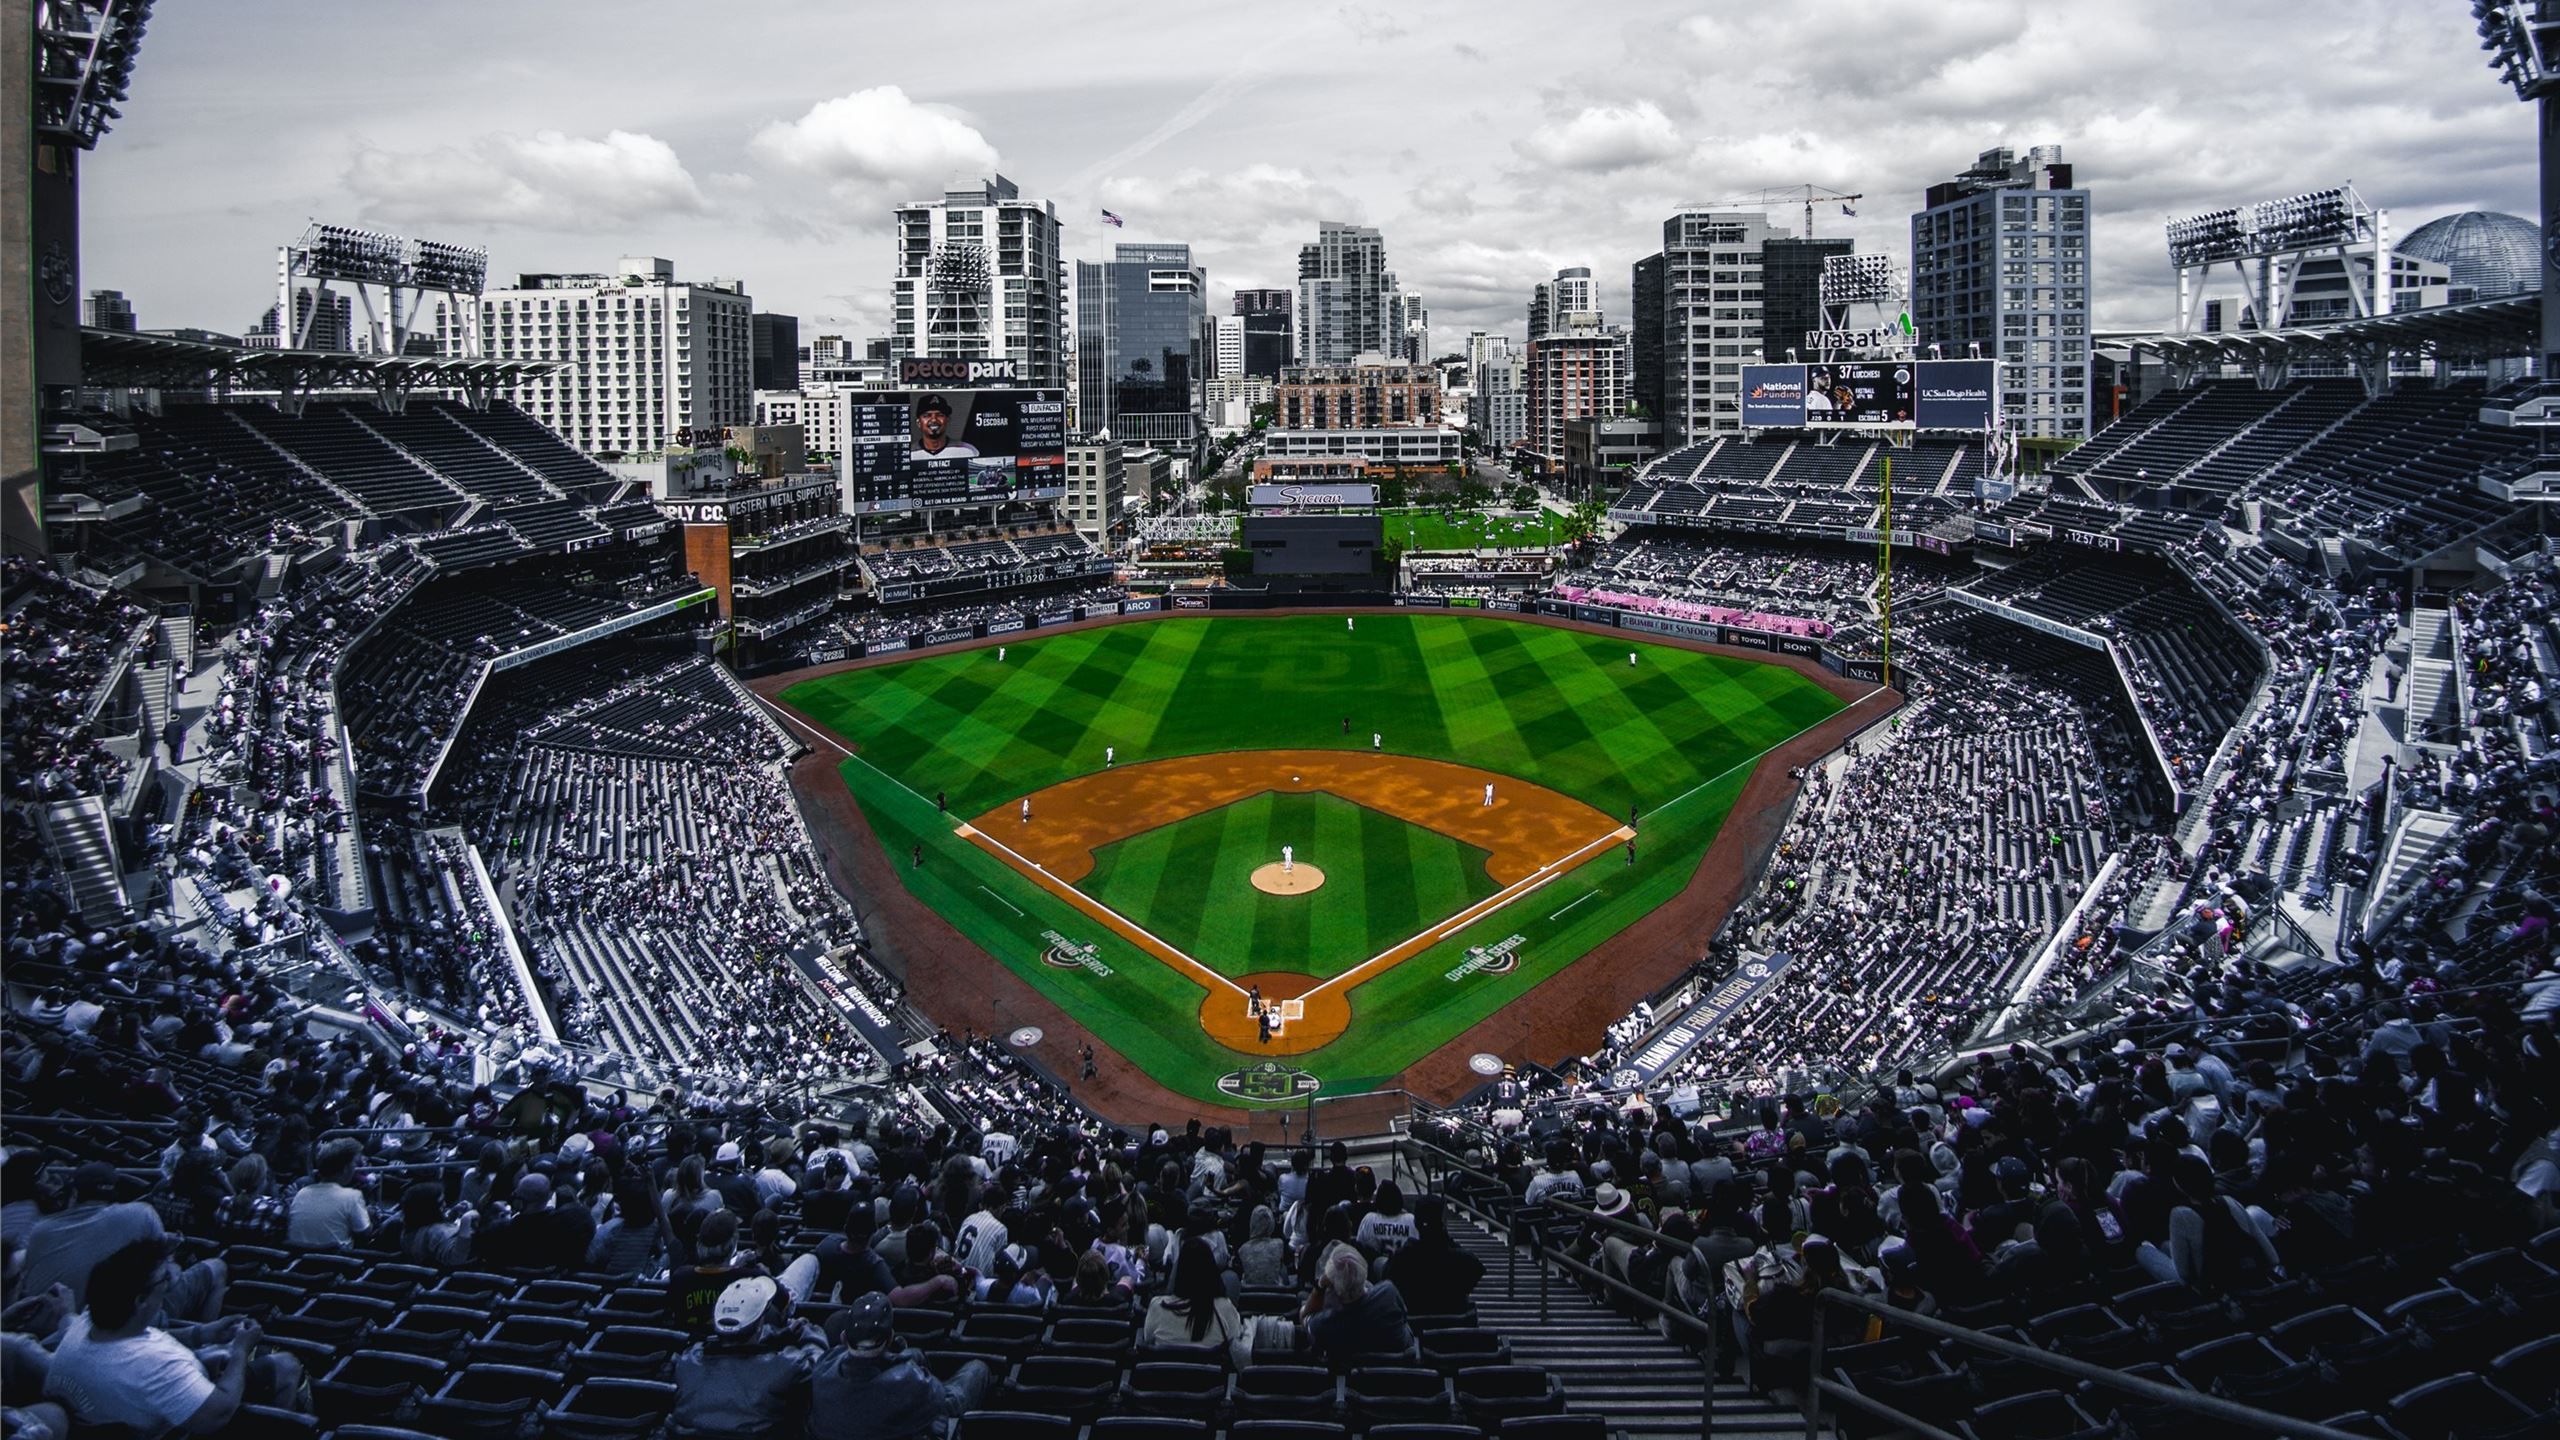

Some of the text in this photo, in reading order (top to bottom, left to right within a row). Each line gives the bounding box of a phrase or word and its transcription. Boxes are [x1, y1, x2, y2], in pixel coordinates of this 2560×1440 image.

[1809, 329, 1881, 349] Viasat
[1839, 365, 1852, 379] 37
[1763, 382, 1801, 391] National
[1763, 391, 1802, 400] Funding
[975, 413, 1008, 426] 5 ESCOBAR
[1881, 410, 1888, 421] 5
[729, 484, 836, 516] WESTERN METAL SUPPLY CO.
[1279, 486, 1344, 509] Sycuan
[700, 505, 728, 521] CO.
[1135, 516, 1239, 531] NATIONAL
[1894, 533, 1911, 543] BEE
[2072, 532, 2093, 545] 12:57
[1126, 601, 1151, 612] ARCO
[1041, 614, 1068, 624] Southwest
[989, 620, 1024, 633] GEICO
[1629, 617, 1718, 637] BUMBLE BEE SEAFOODS
[926, 630, 972, 644] Qualcomm
[1741, 636, 1767, 646] TOYOTA
[1850, 667, 1879, 680] NECA
[1040, 929, 1114, 977] OPENING SERIES
[1445, 933, 1527, 982] OPENING SERIES
[814, 954, 848, 985] WELCOME
[844, 985, 891, 1028] BIENVENIDOS
[1634, 1036, 1675, 1072] THANK
[1684, 1005, 1721, 1031] FRIAR
[1708, 977, 1757, 1010] FAITHFUL
[1544, 1182, 1577, 1194] HOFFMAN
[1373, 1223, 1410, 1238] HOFFMAN
[958, 1224, 979, 1260] 6
